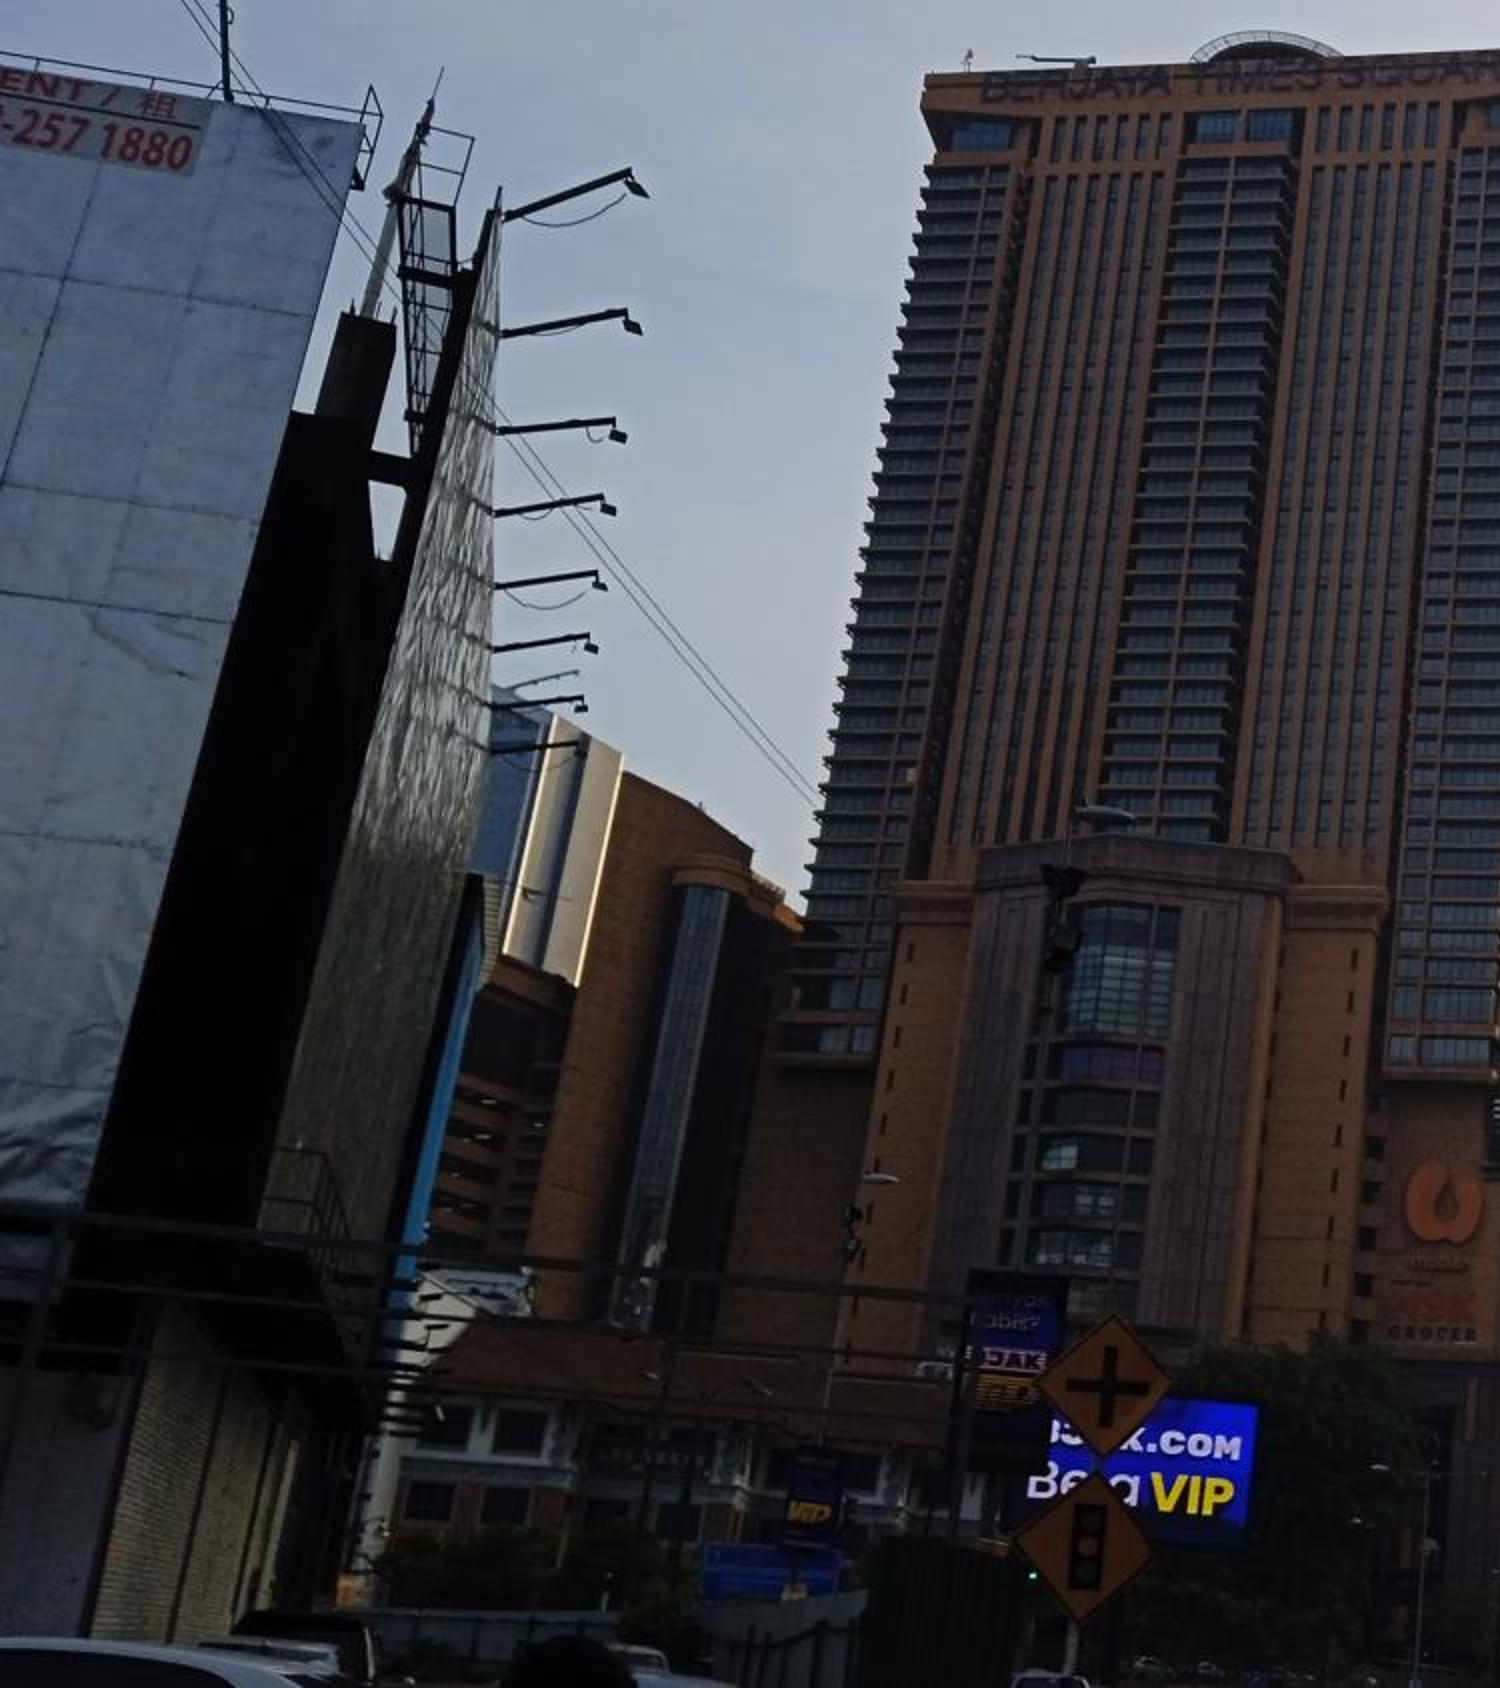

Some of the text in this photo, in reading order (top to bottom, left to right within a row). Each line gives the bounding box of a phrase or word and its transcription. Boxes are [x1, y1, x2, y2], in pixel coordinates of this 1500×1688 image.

[1196, 60, 1321, 94] TIMES
[101, 122, 193, 171] 1880
[1150, 1471, 1235, 1517] VIP
